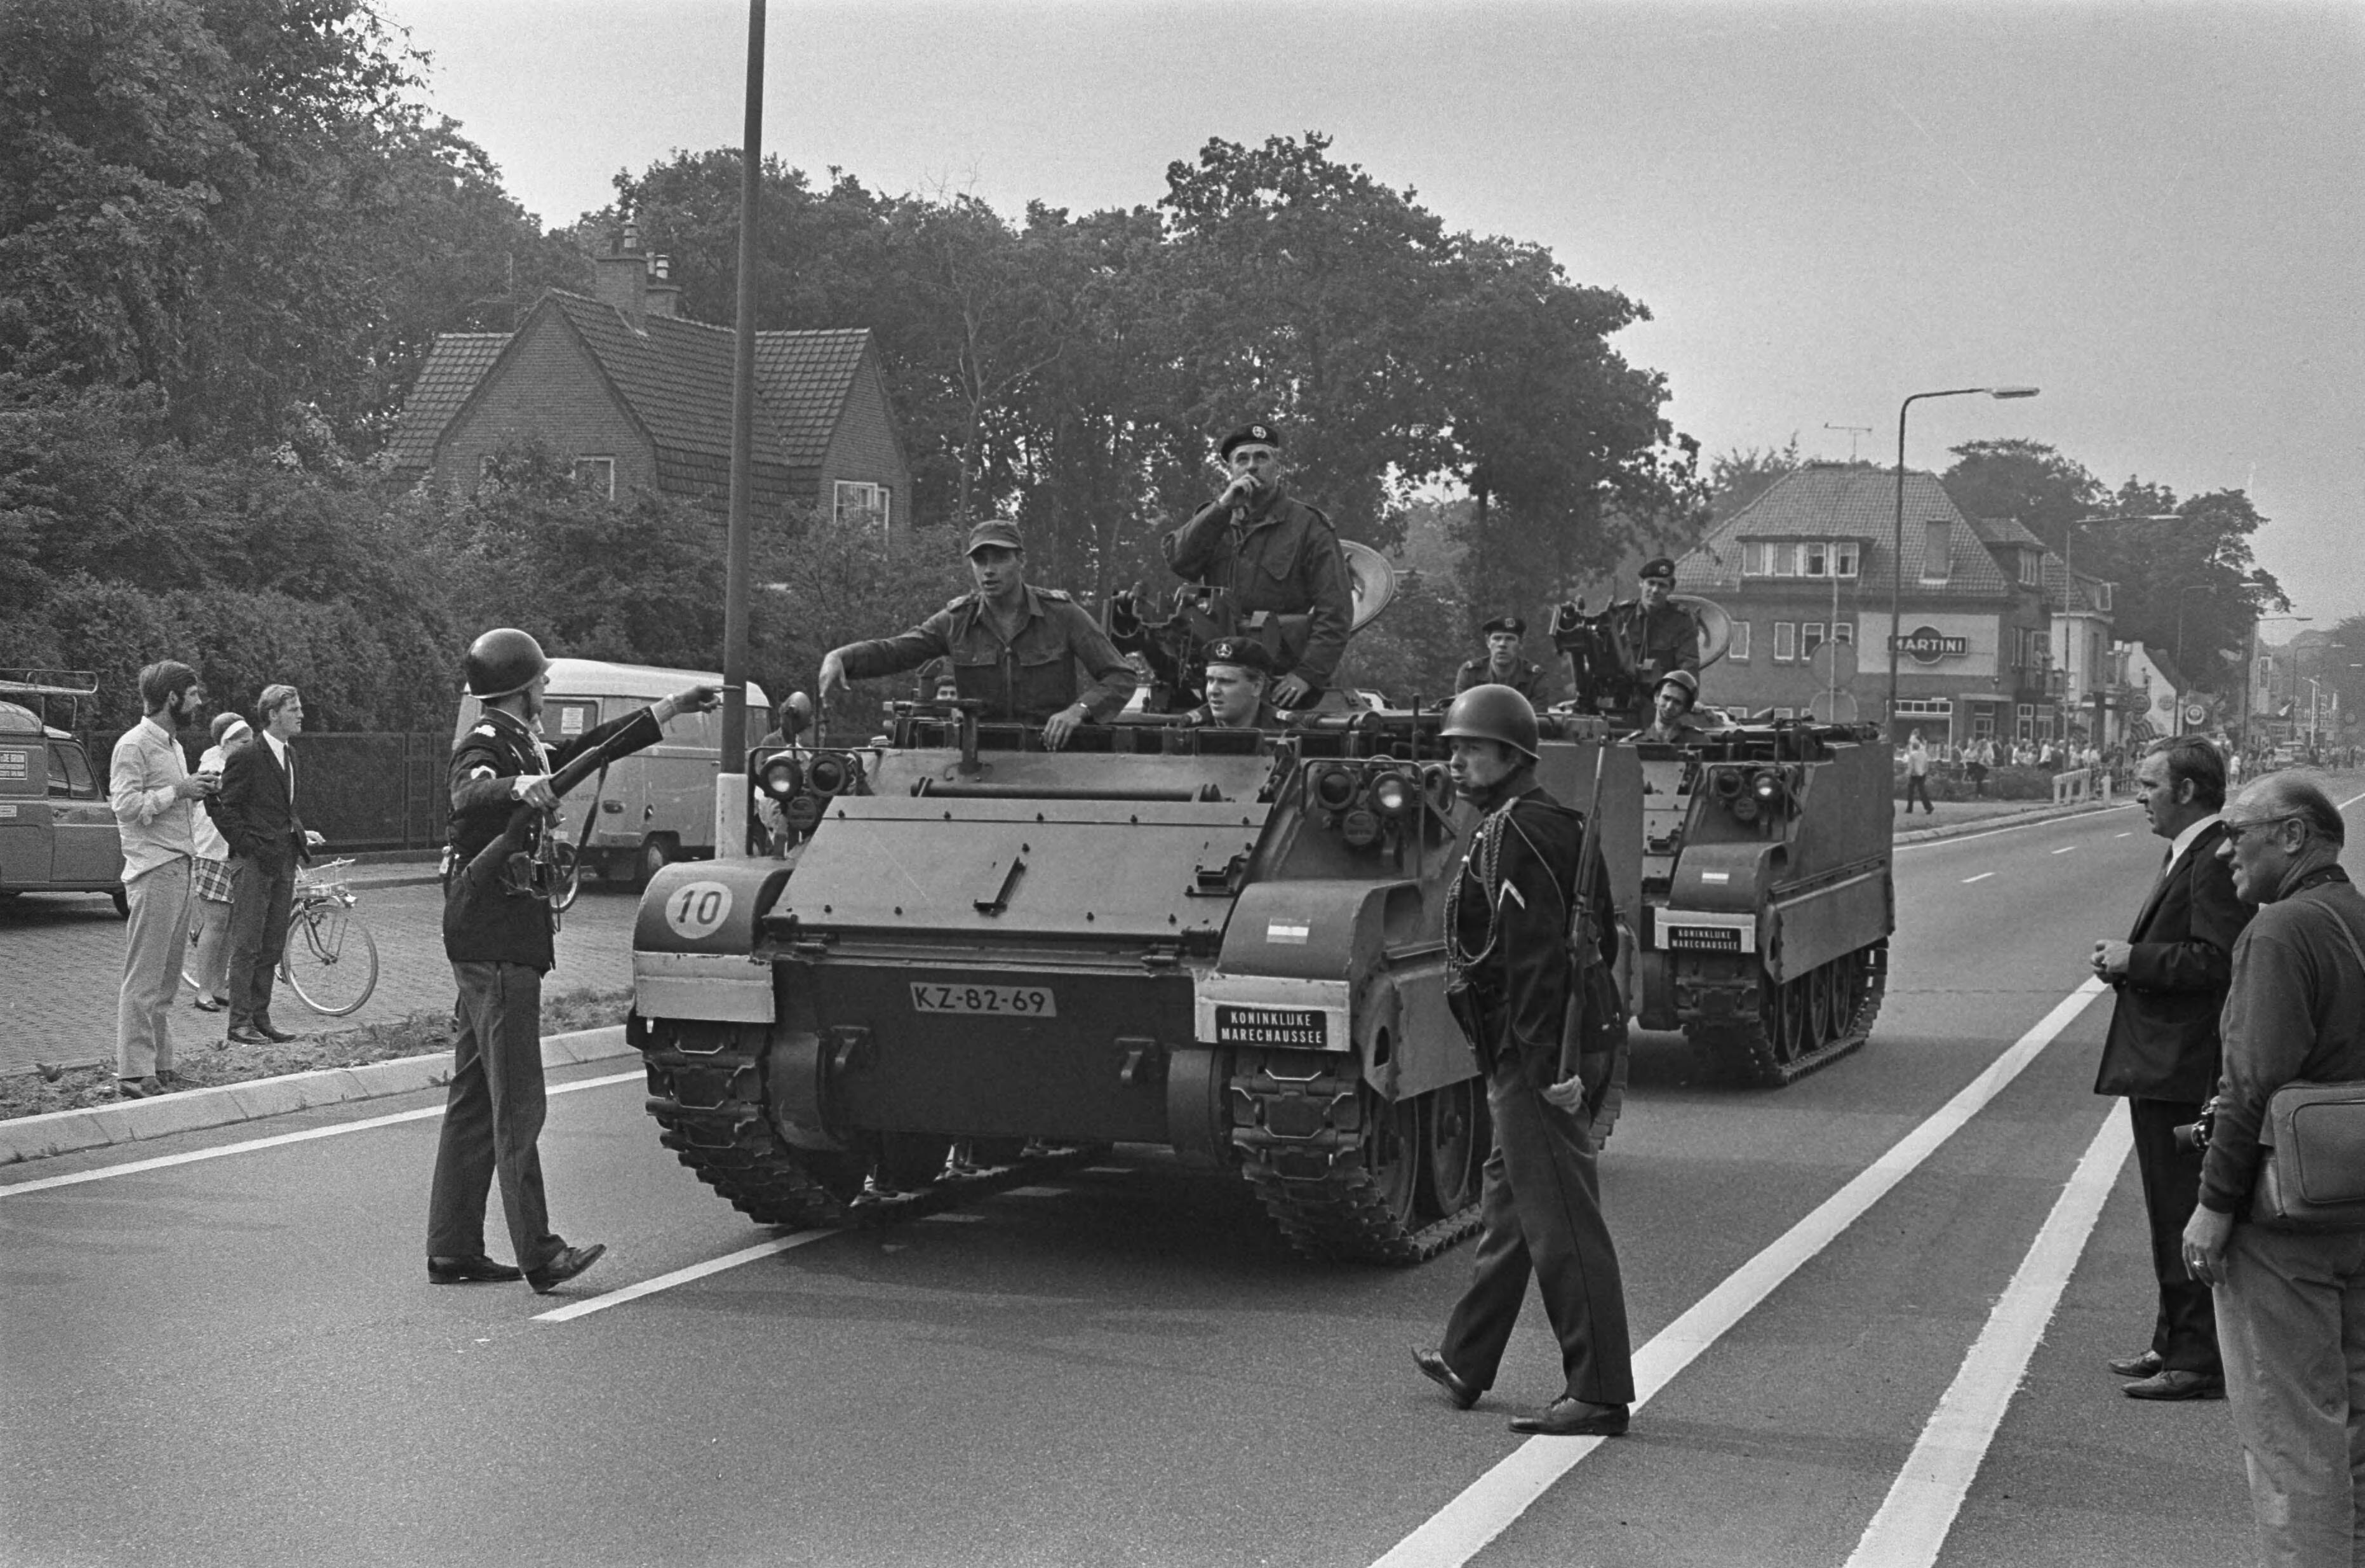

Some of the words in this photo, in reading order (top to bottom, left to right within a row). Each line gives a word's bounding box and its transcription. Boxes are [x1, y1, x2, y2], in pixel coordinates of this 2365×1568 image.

[1896, 638, 1962, 652] MARTINI
[676, 890, 721, 925] 10
[915, 986, 1045, 1013] KZ-82-69
[1221, 1028, 1322, 1043] MARECHAUSSEE
